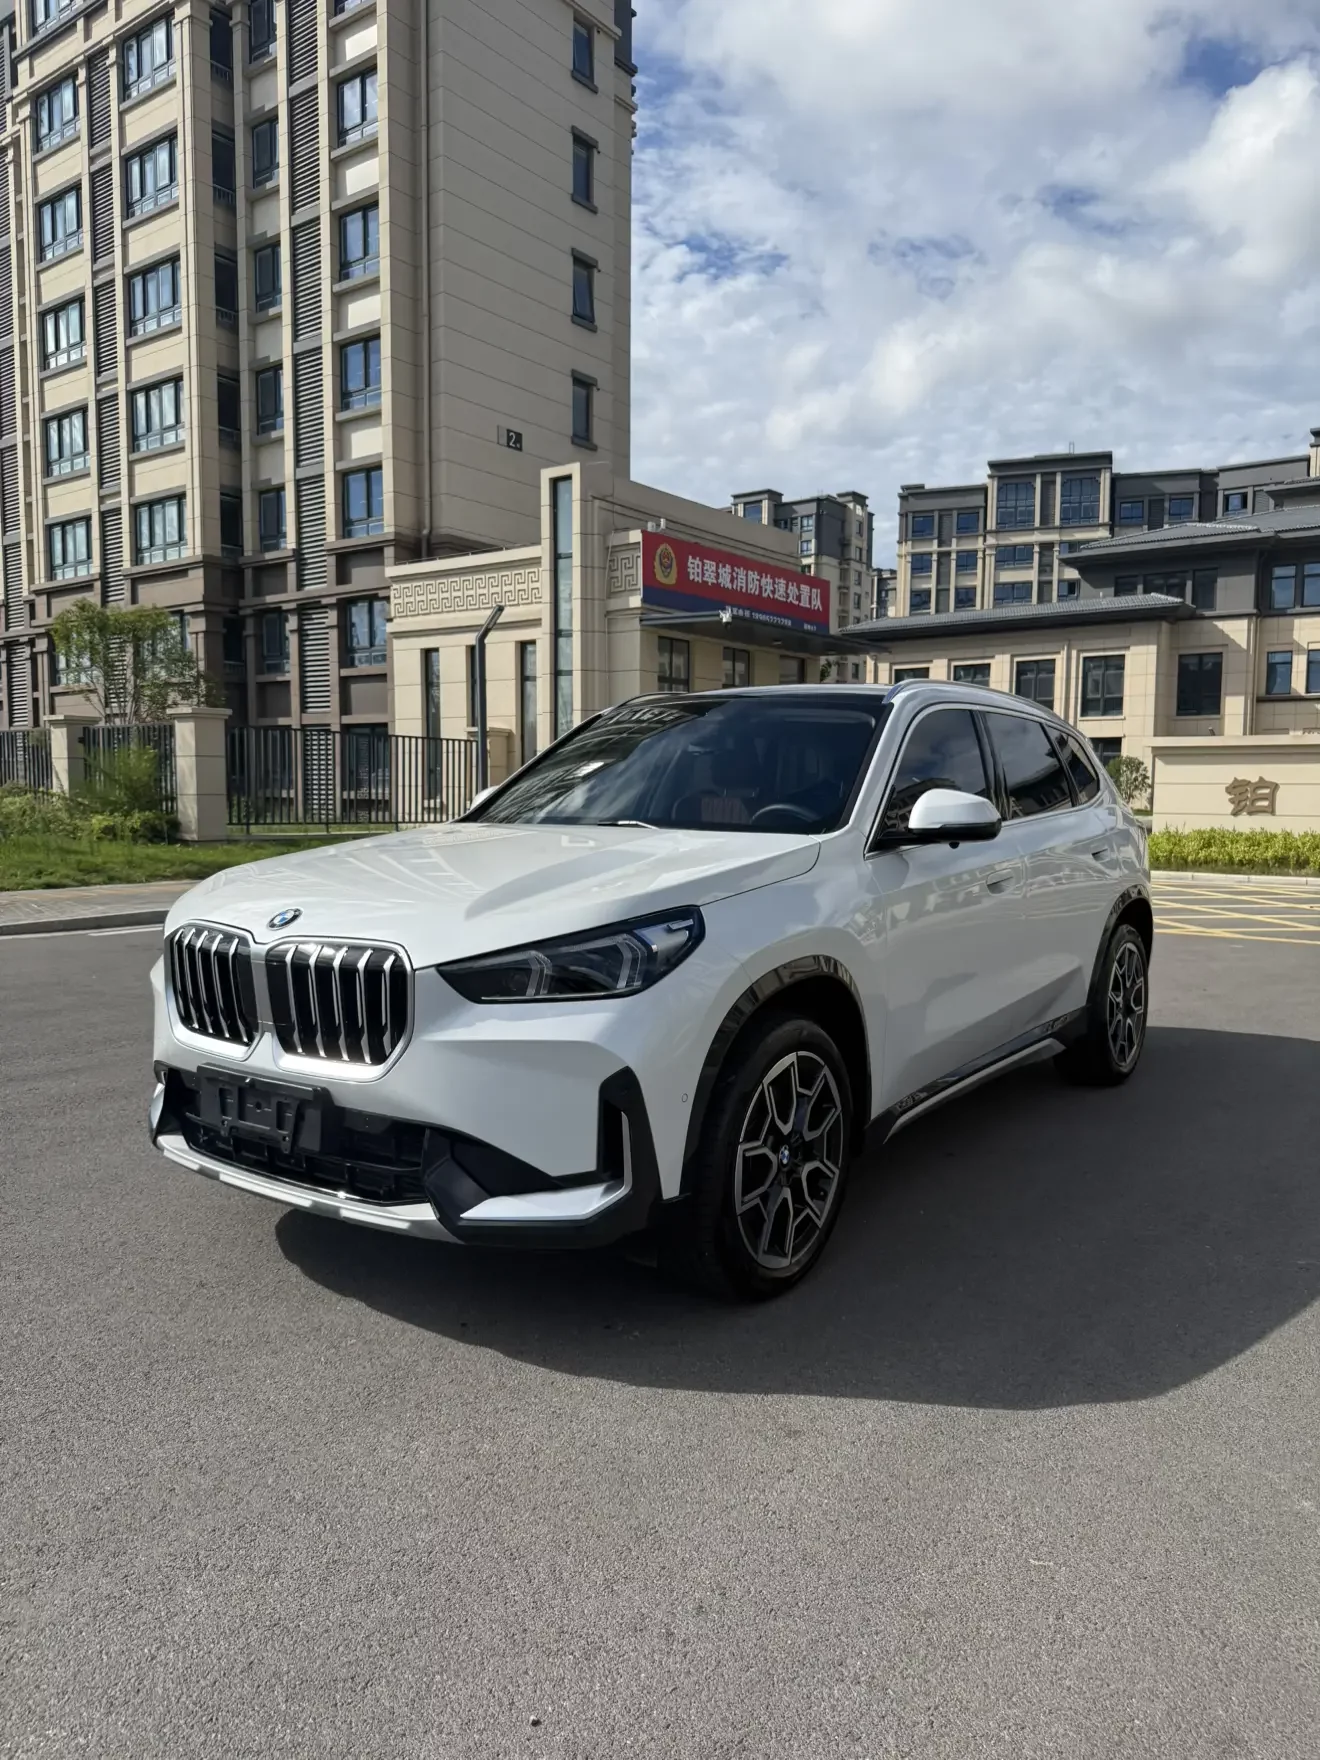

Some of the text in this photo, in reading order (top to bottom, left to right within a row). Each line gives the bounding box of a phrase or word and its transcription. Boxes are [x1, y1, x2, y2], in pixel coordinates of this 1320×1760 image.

[509, 432, 516, 448] 2
[687, 555, 823, 612] 铂翠城消防快速处置队
[1225, 776, 1280, 817] 铂
